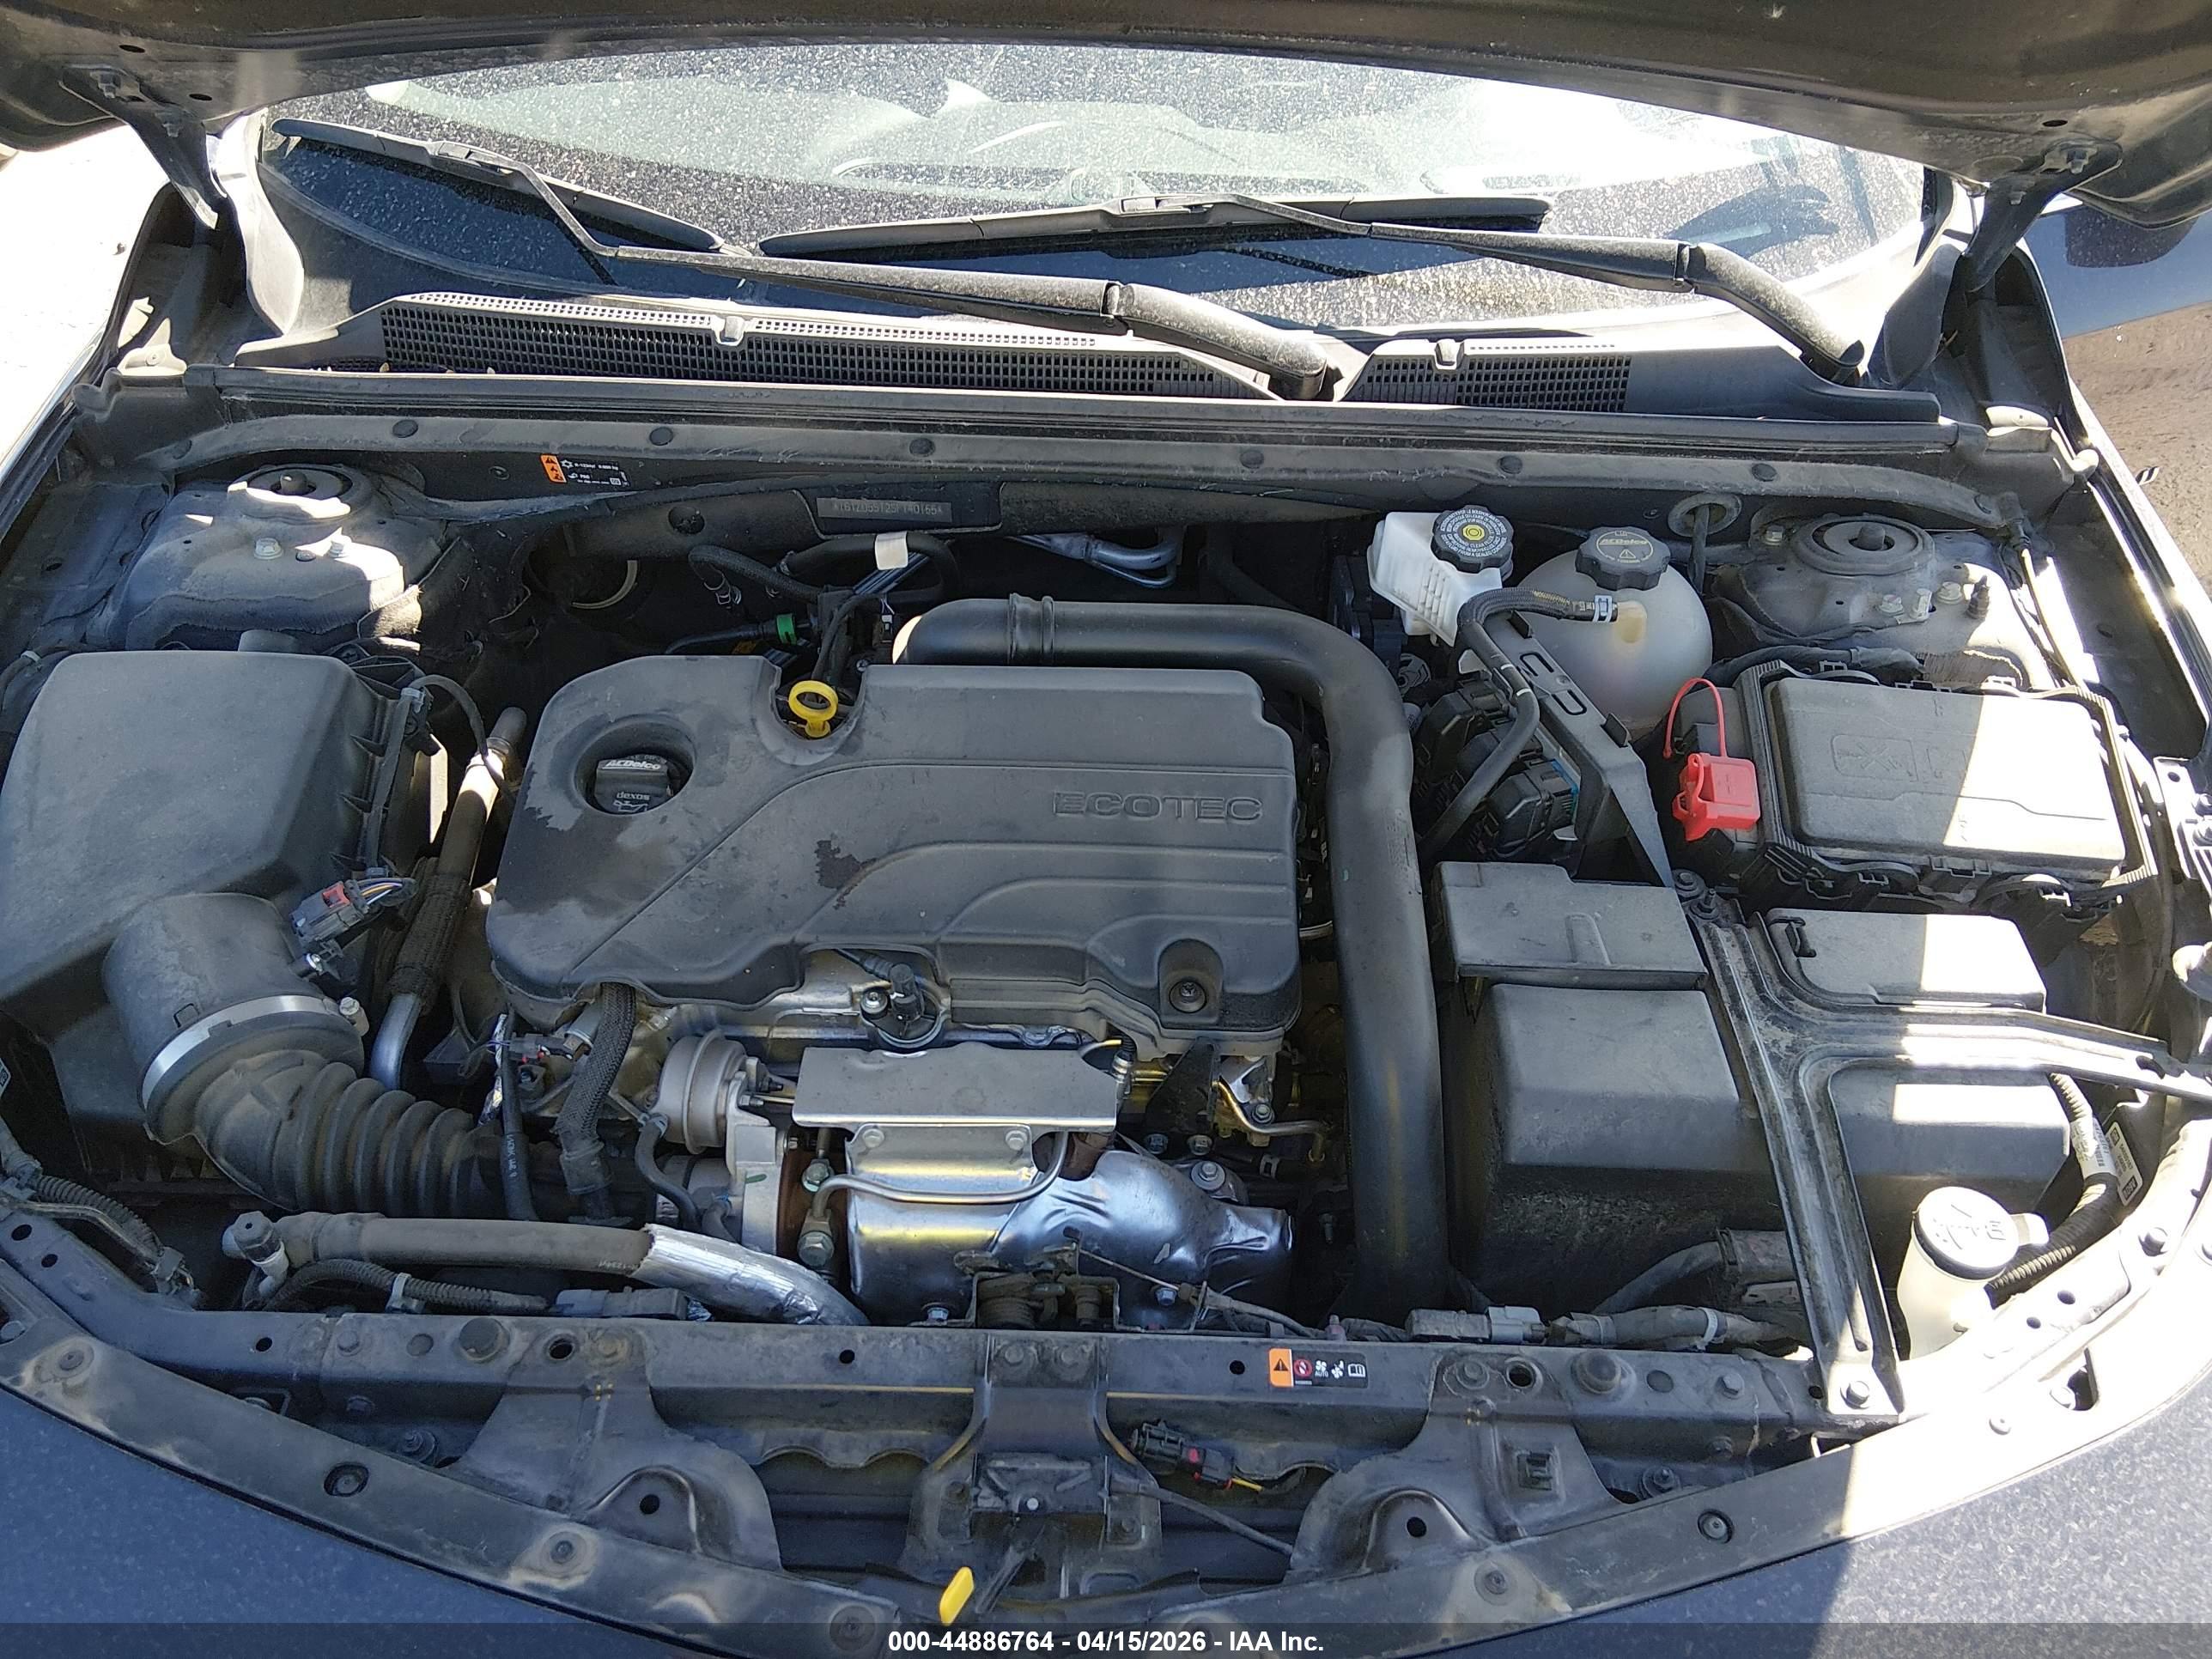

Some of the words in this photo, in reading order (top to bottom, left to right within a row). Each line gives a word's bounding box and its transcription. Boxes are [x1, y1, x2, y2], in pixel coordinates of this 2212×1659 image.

[605, 759, 661, 770] ACDelco
[616, 791, 650, 800] dexos
[1053, 791, 1263, 823] ECOTEC
